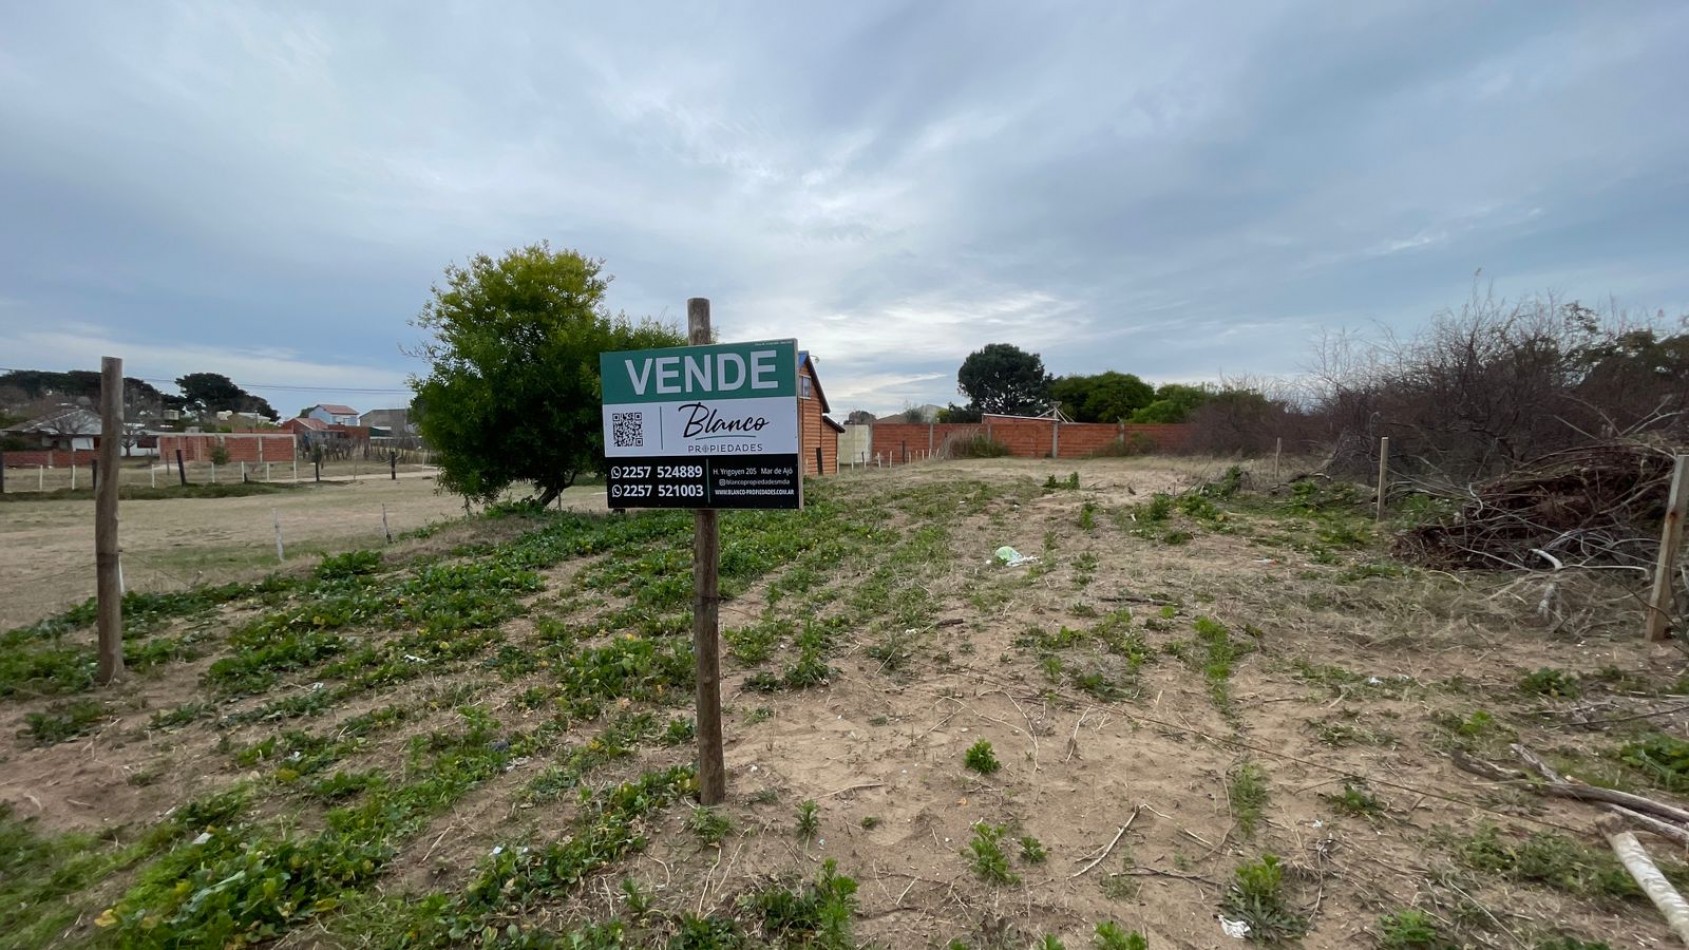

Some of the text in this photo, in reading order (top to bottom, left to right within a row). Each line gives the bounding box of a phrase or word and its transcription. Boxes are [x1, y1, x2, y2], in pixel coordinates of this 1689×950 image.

[625, 350, 778, 395] VENDE
[678, 402, 770, 438] Blanco
[688, 444, 763, 453] PROPIEDADES
[622, 465, 703, 478] 2257 524889
[745, 467, 757, 475] 205
[760, 467, 773, 475] Mar
[773, 467, 782, 475] de
[623, 484, 704, 497] 2257 521003
